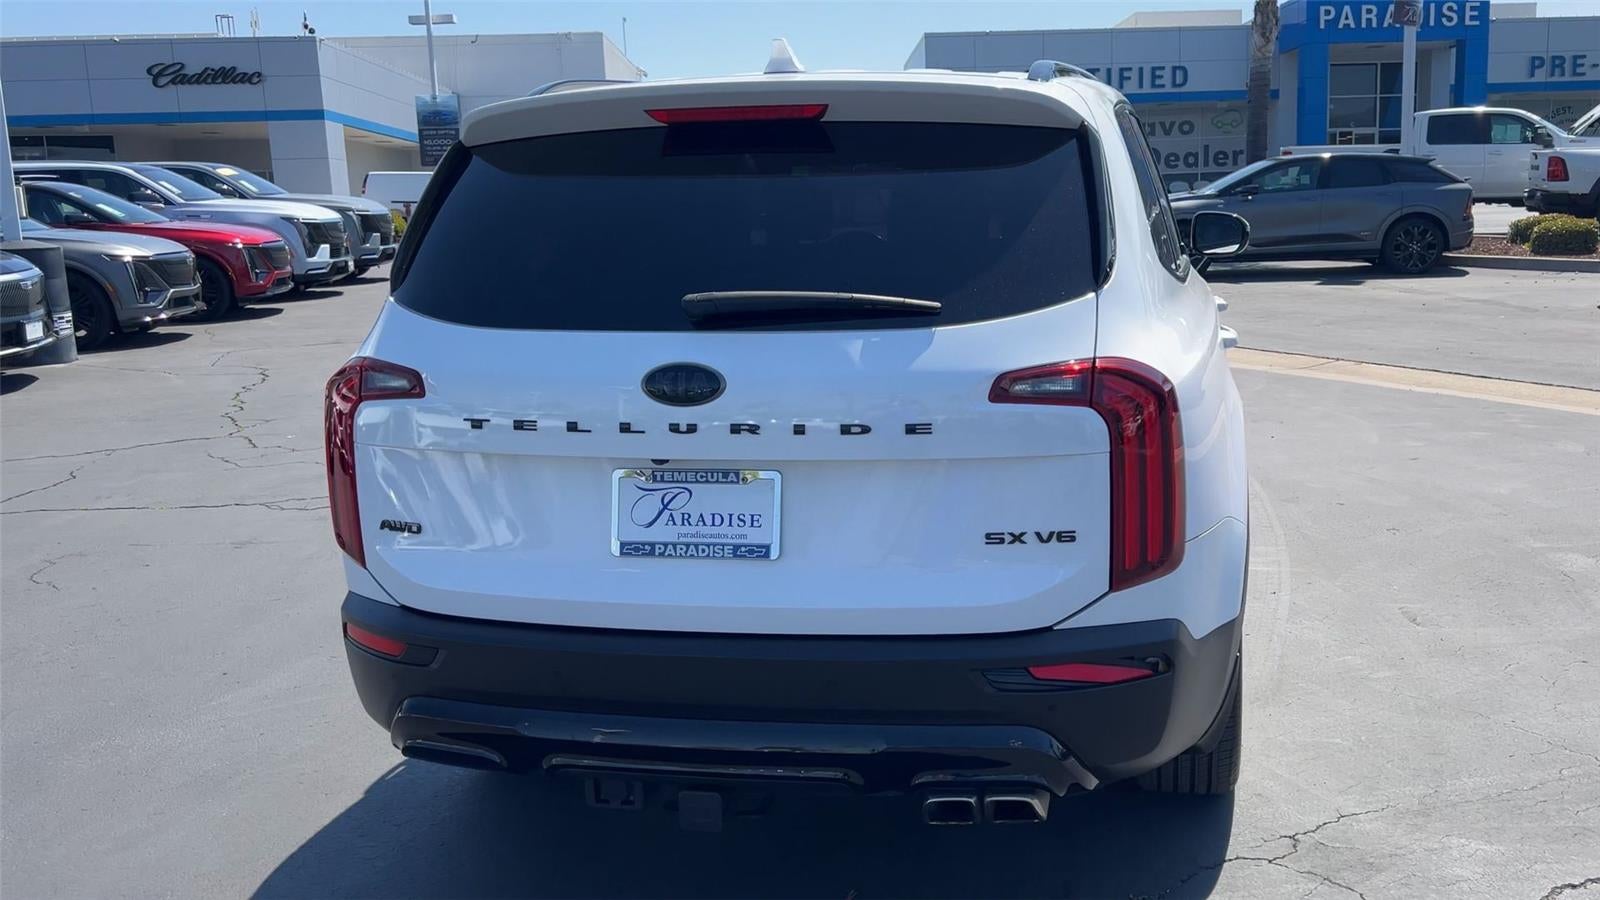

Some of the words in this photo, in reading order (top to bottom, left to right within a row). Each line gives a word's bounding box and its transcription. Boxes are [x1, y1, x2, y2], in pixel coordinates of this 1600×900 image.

[1319, 2, 1480, 29] PARAISE
[146, 62, 263, 88] Cadillac
[1529, 54, 1600, 78] PRE-
[463, 417, 934, 437] TELLURIDE
[654, 471, 738, 483] TEMECULA
[630, 484, 762, 529] PARADISE
[379, 519, 422, 535] AWD
[677, 530, 748, 541] paradiseautos.com
[984, 532, 1028, 545] SX
[1034, 530, 1077, 544] V6
[655, 544, 734, 558] PARADISE
